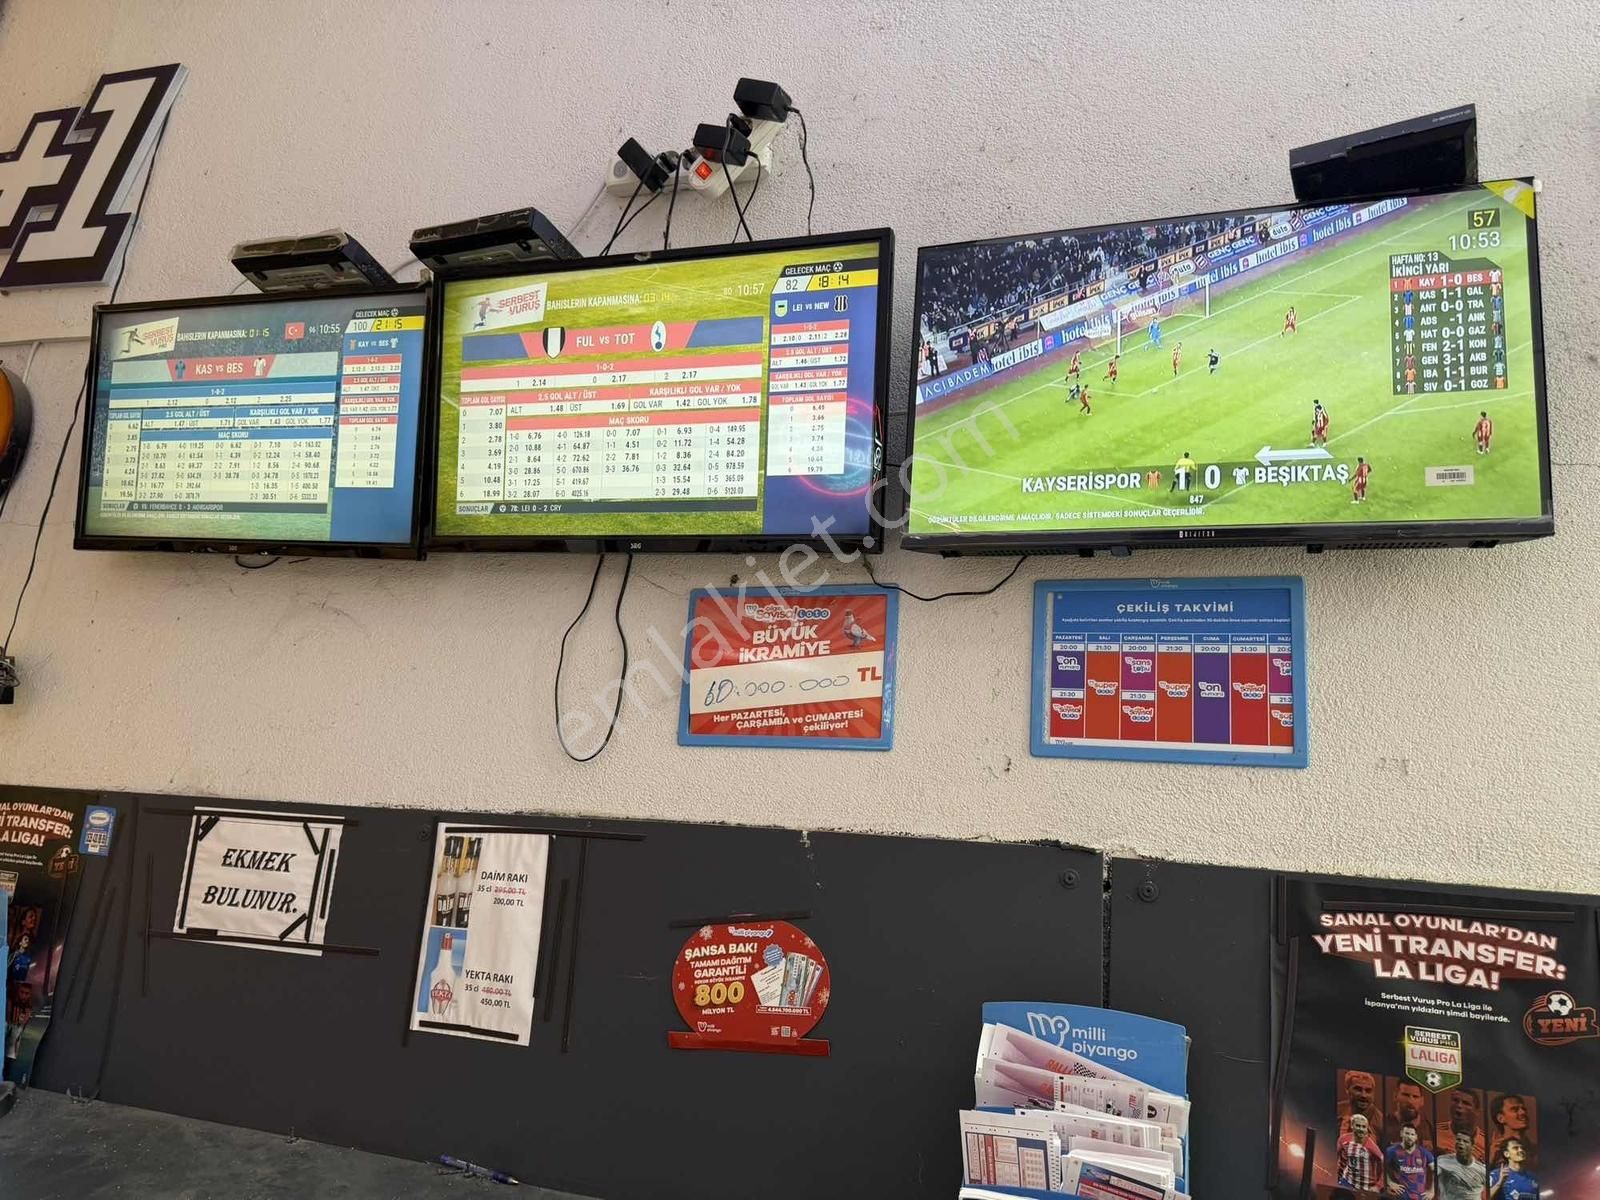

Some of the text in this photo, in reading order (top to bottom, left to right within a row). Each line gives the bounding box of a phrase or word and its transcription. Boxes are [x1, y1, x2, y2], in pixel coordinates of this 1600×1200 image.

[1473, 210, 1496, 227] 57
[1449, 232, 1500, 251] 10:53
[1392, 252, 1439, 265] HAFTA 13
[785, 264, 832, 276] GELECEK MAÇ
[1392, 262, 1449, 277] İKİNCİ YARI
[785, 275, 850, 291] 82 18:14
[1419, 273, 1483, 287] KAY 1-0 BES
[738, 283, 765, 297] 10:57
[1419, 286, 1484, 300] KAS 1-1 GAL
[499, 290, 541, 308] SERBEST
[1420, 299, 1484, 313] ANT 0-0 TRA
[509, 300, 541, 315] VURUŞ
[792, 301, 830, 312] LEI NEW
[353, 318, 403, 331] 100 21:15
[1420, 312, 1485, 326] ADS -1 ANK
[319, 323, 341, 334] 10:55
[1421, 326, 1486, 339] HAT 0-0 GAZ
[576, 332, 636, 348] FUL TOT
[1422, 339, 1487, 352] FEN 2-1 KON
[1422, 352, 1487, 365] GEN 3-1 AKB
[195, 362, 244, 375] KAS BES
[1423, 365, 1488, 378] IBA 1-1 BUR
[532, 370, 698, 387] 2.14 2.17 2.17
[924, 364, 994, 397] ACIBADEM
[1423, 378, 1489, 392] SIV 0-1 GOZ
[583, 389, 597, 399] ÜST
[689, 384, 742, 394] GOL VAR YOK
[510, 396, 758, 414] ALT 1.48 1.69 GOL VAR 1.42 GOL YOK 1.78
[608, 415, 650, 425] MAÇ SKORU
[626, 427, 693, 437] 7.07 6.93
[674, 437, 745, 448] 11.72 54.28
[621, 465, 640, 473] 36.76
[673, 476, 691, 484] 15.54
[1021, 471, 1141, 493] KAYSERİSPOR
[1175, 467, 1188, 491] 1
[1204, 464, 1222, 489] 0
[1189, 494, 1204, 504] 847
[550, 504, 562, 512] CRY
[1082, 509, 1123, 519] SİSTEMDEKİ
[1123, 509, 1162, 519] SONUÇLAR
[1116, 600, 1234, 614] ÇEKİLİŞ TAKVİMİ
[752, 621, 819, 645] BÜYÜK
[738, 639, 831, 663] İKRAMİYE
[857, 666, 882, 683] TL
[713, 707, 786, 723] Her PAZARTESİ,
[736, 708, 864, 730] ÇARŞAMBA ve CUMARTESİ
[803, 721, 849, 733] çekiliyor!
[12, 802, 74, 822] OYUNLAR'DAN
[6, 815, 74, 839] TRANSFER:
[11, 830, 46, 847] LIGA!
[220, 848, 298, 874] EKMEK
[481, 869, 529, 884] DAİM RAKI
[477, 884, 485, 893] 35
[201, 884, 299, 914] BULUNUR.
[493, 897, 525, 907] 200,00 TL
[1319, 913, 1558, 950] SANAL OYUNLAR'DAN
[684, 942, 758, 961] ŞANSA BAK!
[1312, 927, 1567, 981] YENİ TRANSFER:
[690, 956, 752, 969] TAMAMI DAĞITIM
[465, 968, 514, 985] YEKTA RAKI
[694, 964, 747, 979] GARANTİLİ
[1373, 958, 1501, 991] LA LIGA!
[464, 983, 473, 992] 35
[695, 981, 745, 1007] 800
[480, 997, 511, 1009] 450,00 TL
[1380, 992, 1493, 1012] Serbest Vuruş Pro La Liga ile
[702, 1007, 726, 1015] MİLYON
[1364, 997, 1511, 1024] İspanya'nın yıldızları şimdi bayilerde.
[1537, 1012, 1588, 1034] YENİ
[1072, 1026, 1106, 1042] milli
[1414, 1030, 1452, 1041] SERBEST
[1072, 1040, 1138, 1062] piyango
[1409, 1048, 1457, 1065] LALIGA
